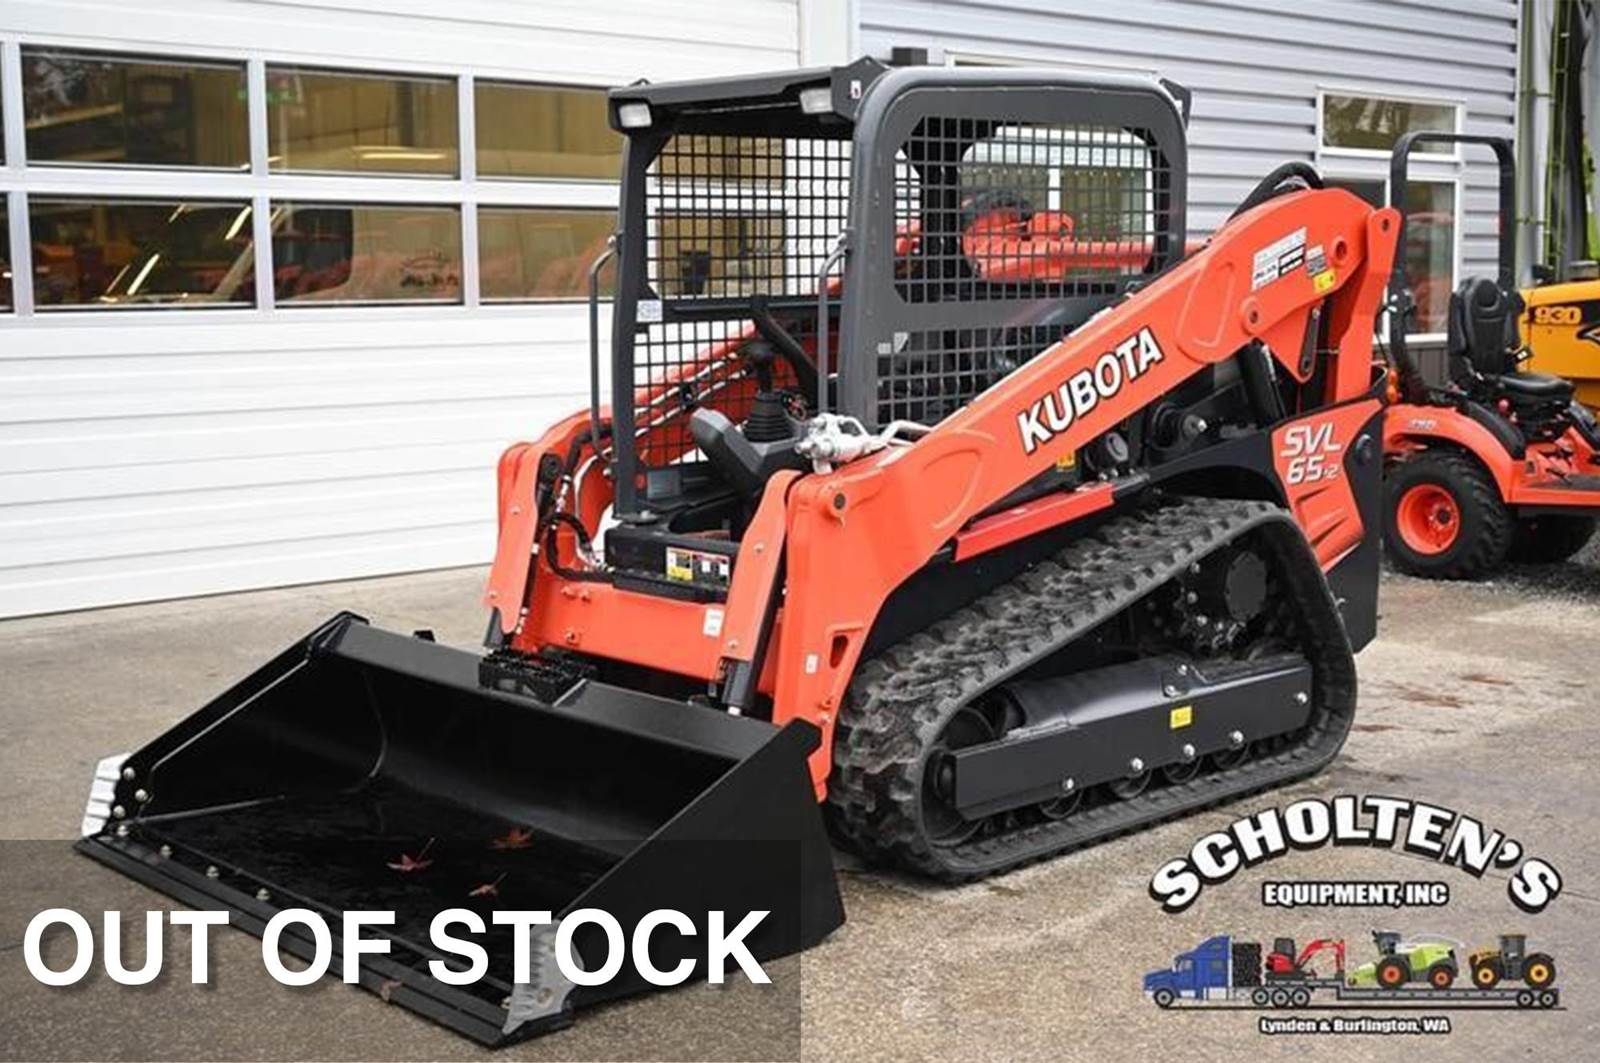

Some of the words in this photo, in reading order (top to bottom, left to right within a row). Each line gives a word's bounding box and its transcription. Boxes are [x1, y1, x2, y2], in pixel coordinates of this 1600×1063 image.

[1535, 306, 1582, 324] 930
[1017, 327, 1163, 453] KUBOTA
[1280, 423, 1342, 457] SVL
